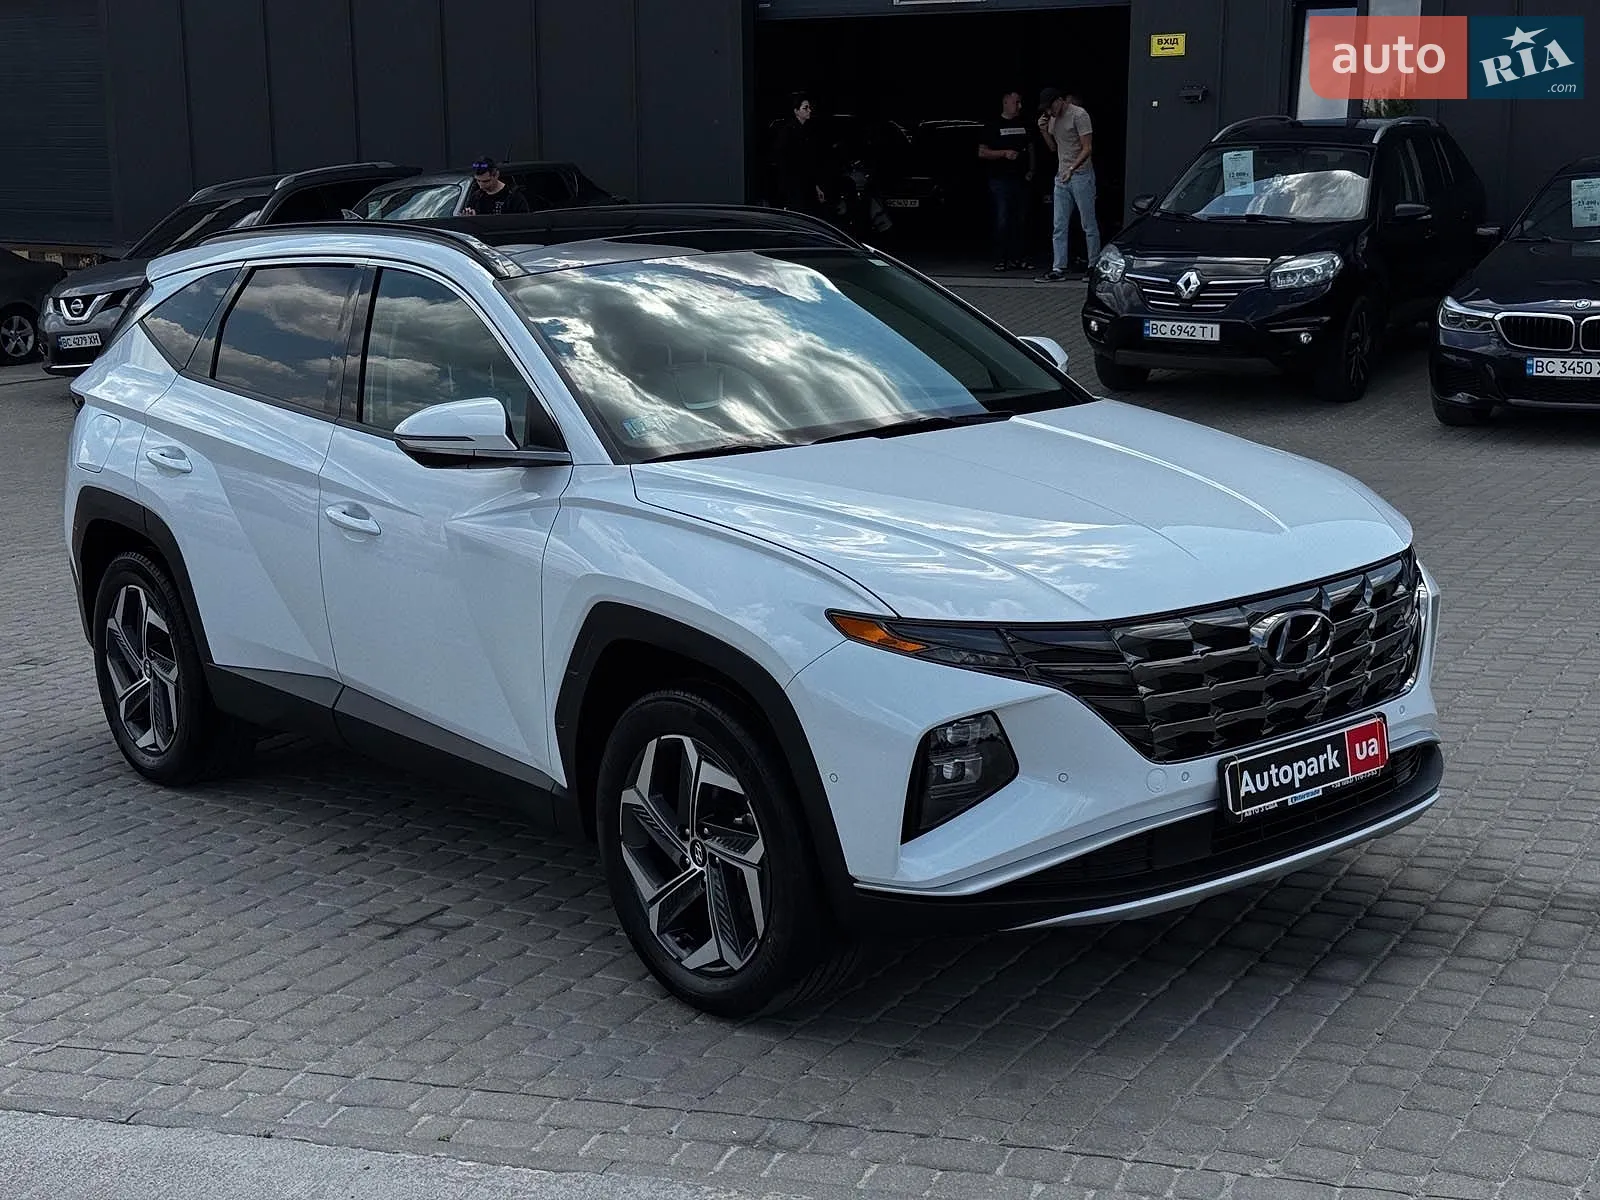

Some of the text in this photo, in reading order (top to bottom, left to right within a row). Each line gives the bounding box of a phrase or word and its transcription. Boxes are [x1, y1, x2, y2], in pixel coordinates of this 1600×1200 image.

[1157, 37, 1179, 46] ВХІД
[1150, 323, 1168, 336] BC
[1169, 324, 1197, 338] 6942
[1535, 360, 1556, 374] BC
[1559, 360, 1593, 375] 3450
[1240, 743, 1341, 797] Autopark
[1355, 737, 1380, 761] ua
